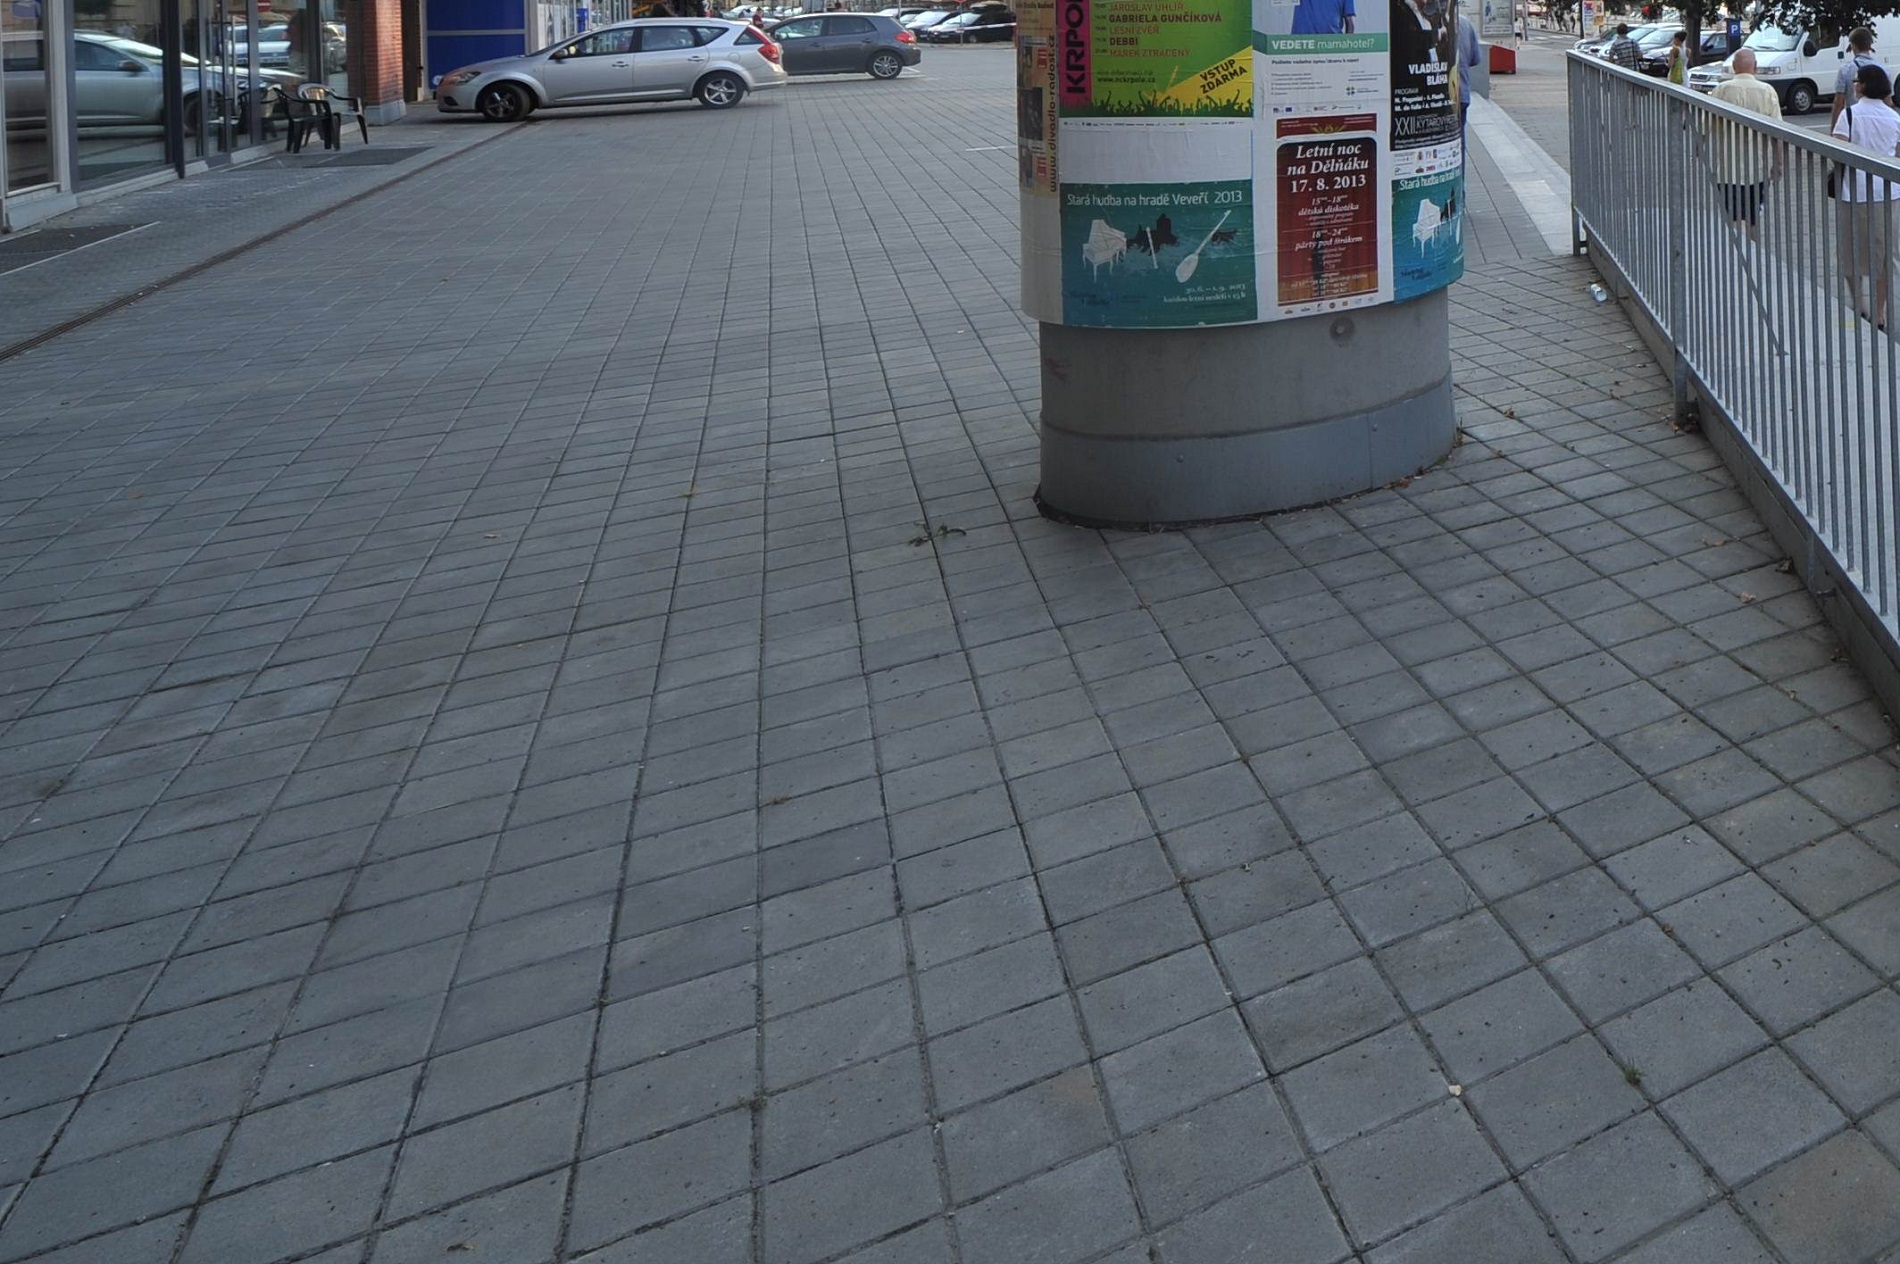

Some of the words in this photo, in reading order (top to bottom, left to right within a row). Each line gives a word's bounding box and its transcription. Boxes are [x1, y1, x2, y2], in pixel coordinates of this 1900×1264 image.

[1109, 3, 1153, 13] JAROSLAV
[1109, 14, 1158, 23] GABRIELA
[1160, 11, 1222, 23] GUNČÍKOVÁ
[1731, 24, 1738, 34] P
[1271, 39, 1315, 50] VEDETE
[1317, 38, 1375, 49] mamahotel?
[1200, 58, 1236, 82] VSTUP
[1408, 61, 1448, 75] VLADISLAV
[1200, 65, 1248, 94] ZDARMA
[1296, 142, 1335, 159] Letní
[1337, 144, 1362, 156] noc
[1287, 164, 1306, 176] na
[1310, 156, 1369, 174] Dělňáku
[1291, 179, 1312, 194] 17.
[1316, 178, 1329, 191] 8.
[1333, 174, 1367, 190] 2013
[1400, 179, 1420, 191] Stará
[1067, 194, 1090, 206] Stará
[1093, 193, 1122, 206] hudba
[1124, 196, 1137, 206] na
[1139, 192, 1170, 206] hradě
[1172, 191, 1209, 206] Veveří
[1214, 190, 1243, 204] 2013
